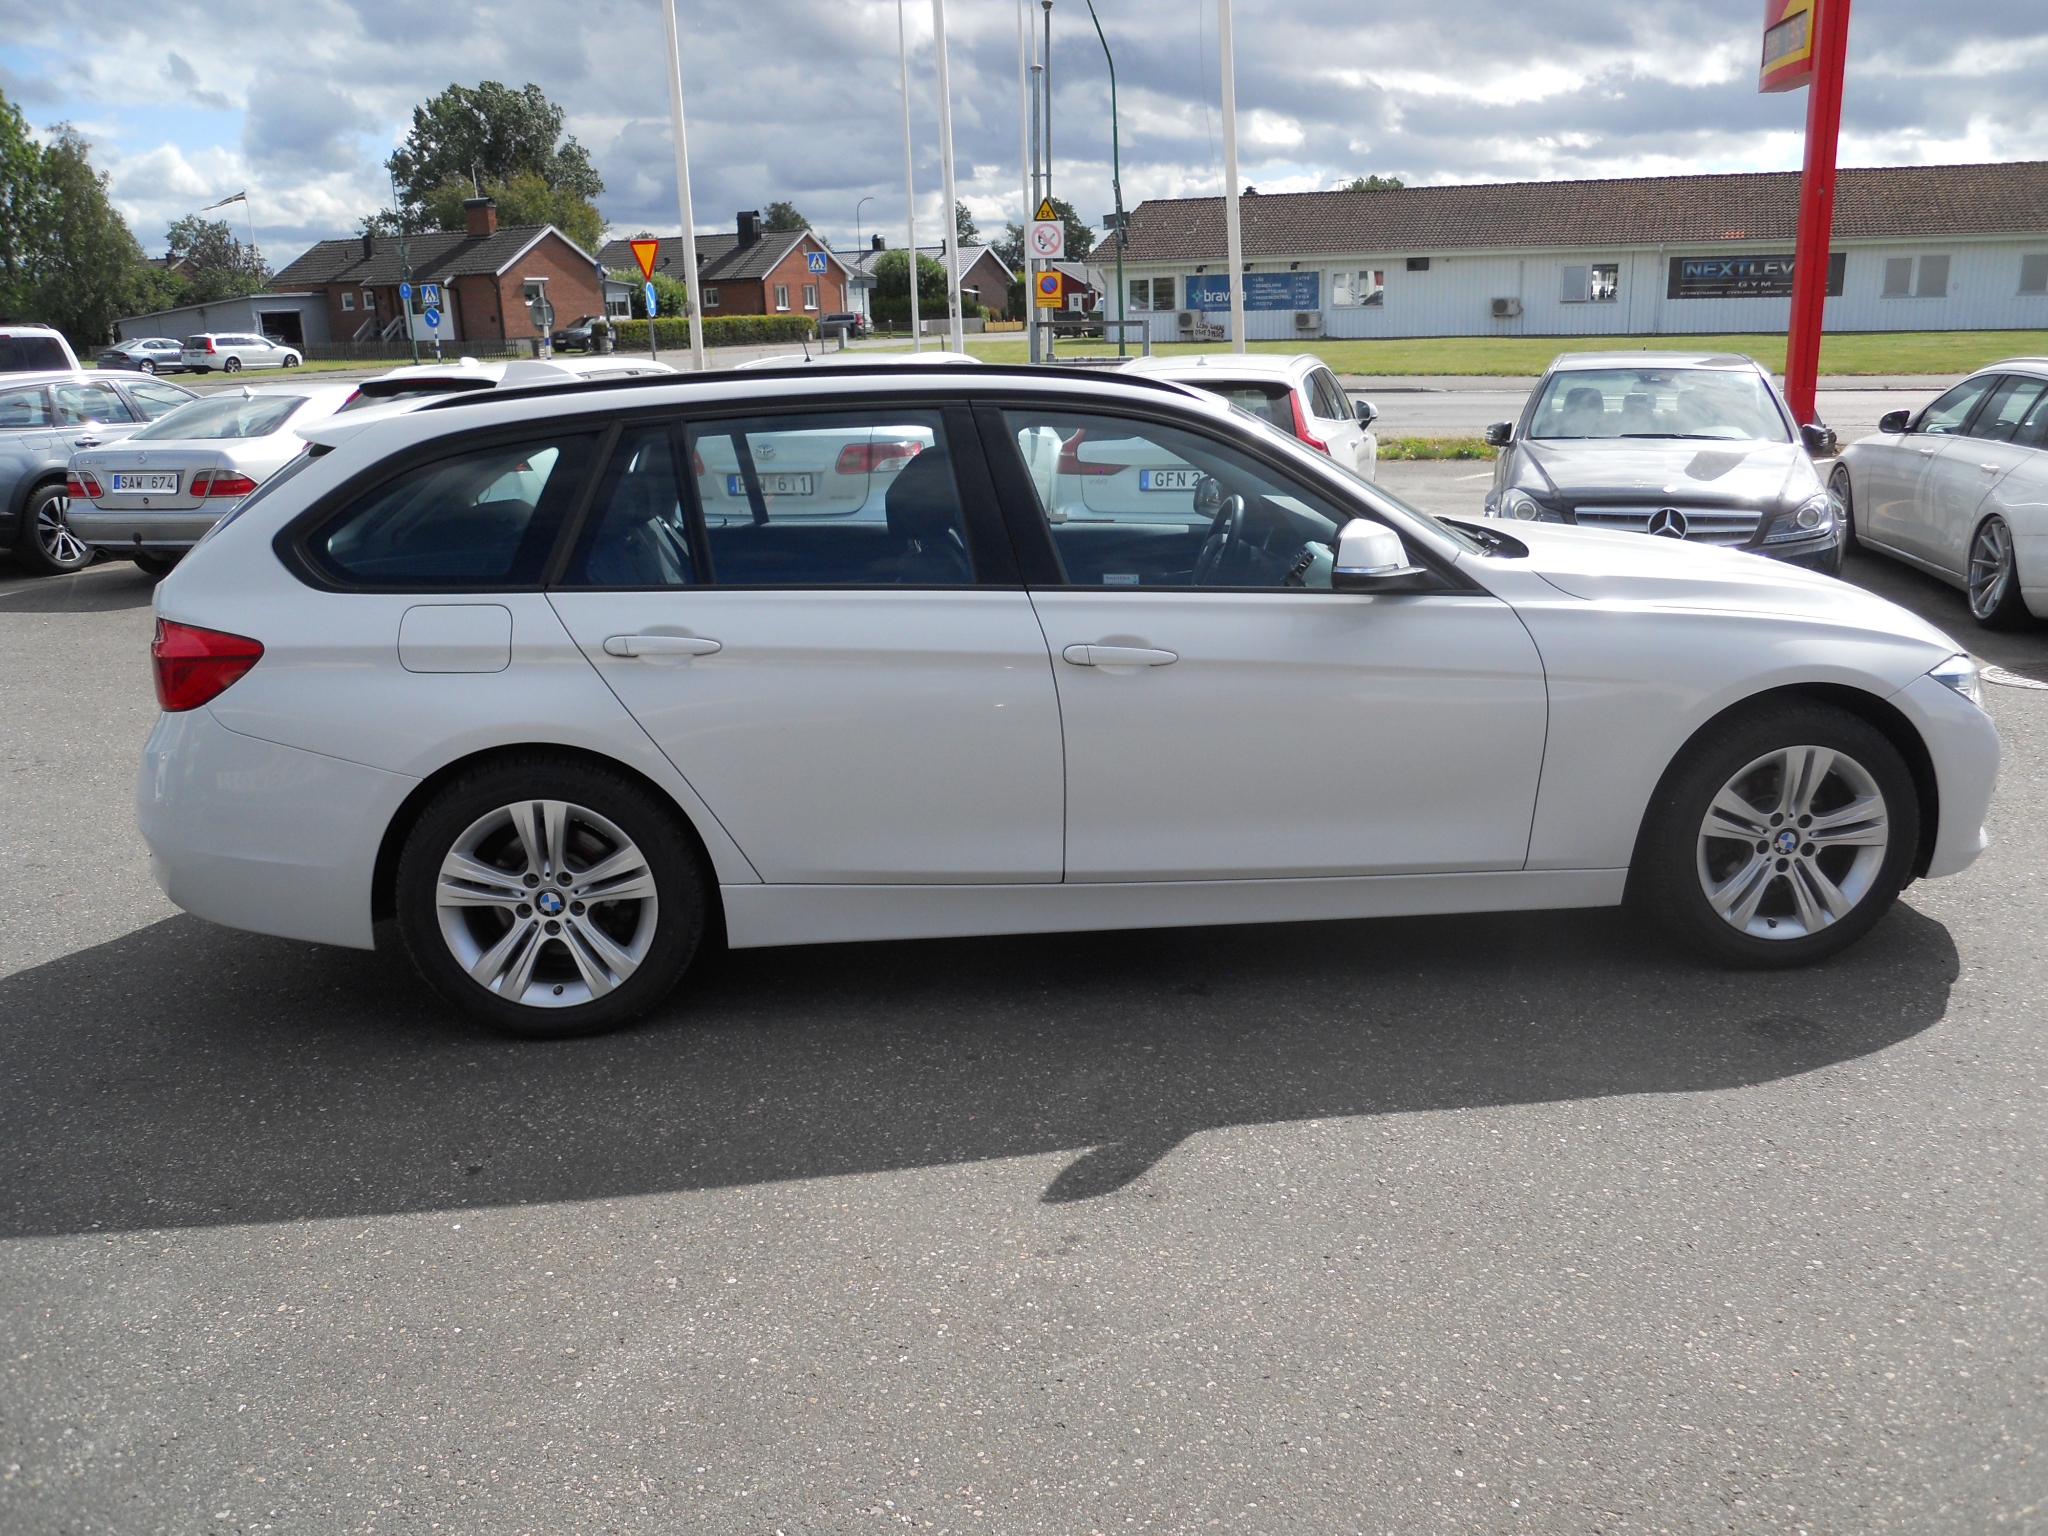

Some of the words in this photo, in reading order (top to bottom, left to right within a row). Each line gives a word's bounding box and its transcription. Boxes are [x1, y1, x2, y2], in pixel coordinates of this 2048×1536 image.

[1041, 210, 1051, 218] EX
[1686, 259, 1795, 278] NEXTLEV
[1204, 290, 1247, 302] brava
[121, 475, 143, 489] SAW
[151, 475, 174, 489] 674
[1155, 472, 1186, 487] GFN
